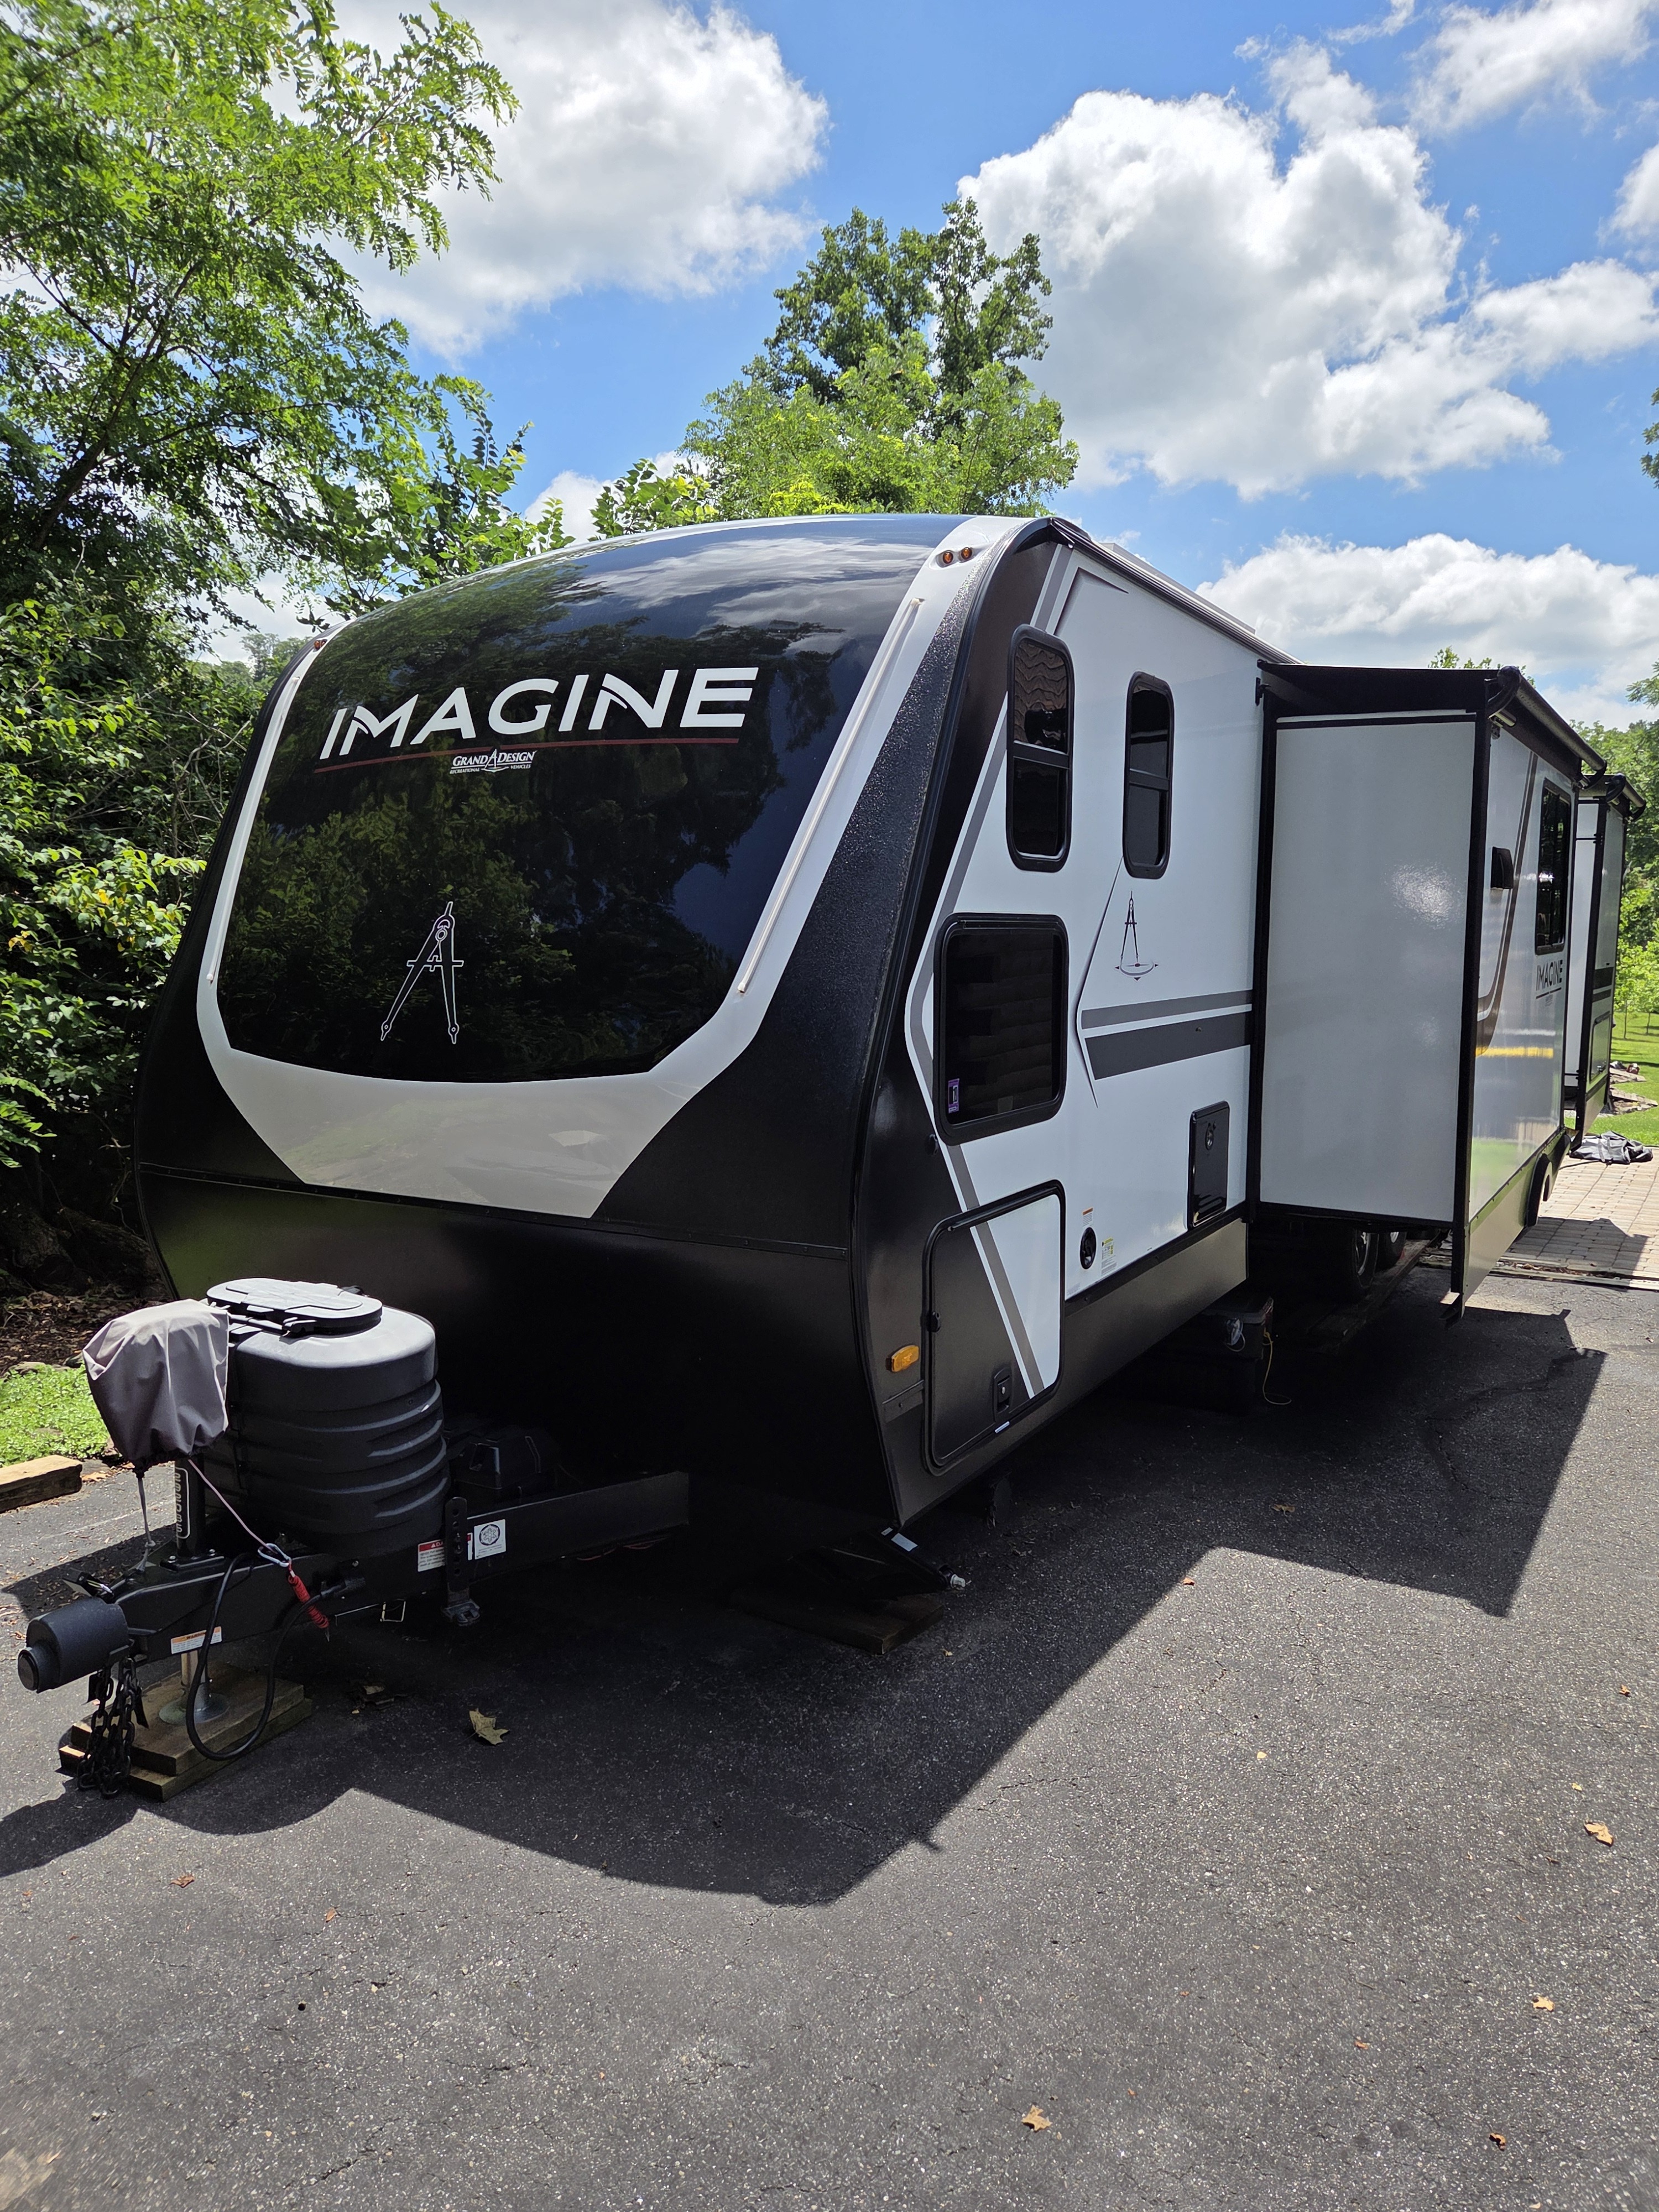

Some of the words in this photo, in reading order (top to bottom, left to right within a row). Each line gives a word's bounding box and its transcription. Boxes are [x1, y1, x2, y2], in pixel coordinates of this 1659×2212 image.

[320, 667, 759, 760] IMAGINE
[452, 756, 488, 766] GRAND
[497, 750, 538, 763] DESIGN
[1536, 959, 1563, 991] IMAGINE
